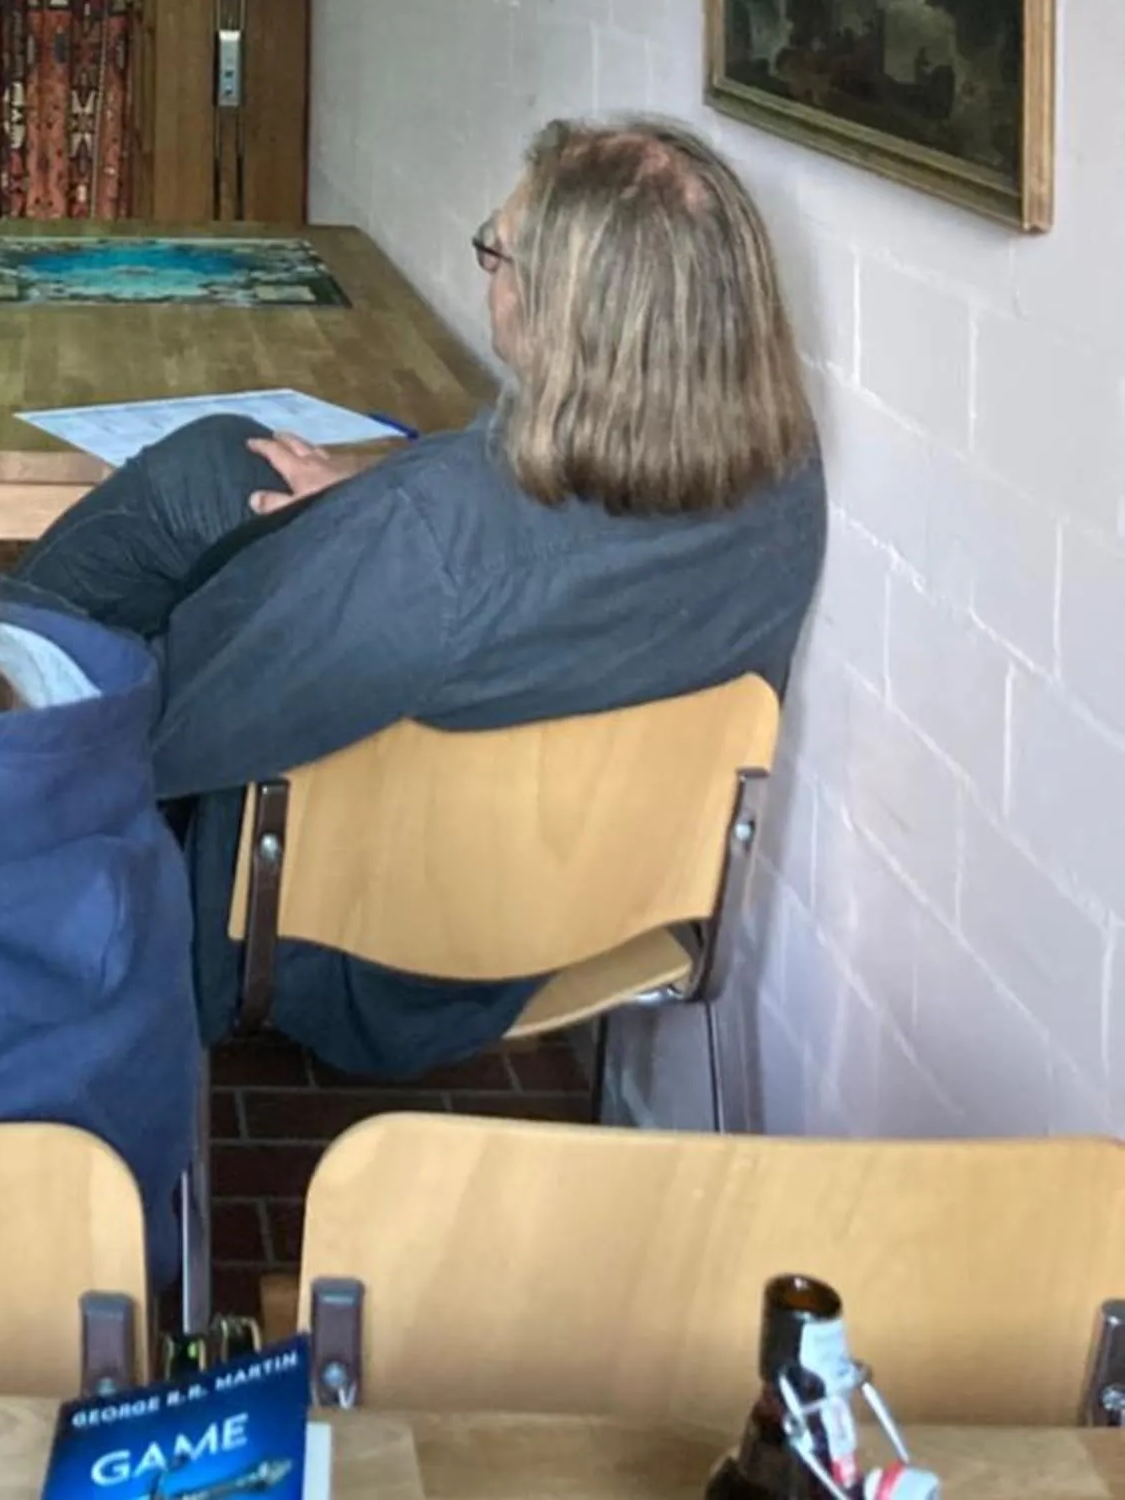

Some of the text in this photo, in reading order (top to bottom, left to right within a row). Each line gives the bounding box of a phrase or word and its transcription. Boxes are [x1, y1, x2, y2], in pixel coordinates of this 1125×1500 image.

[71, 1395, 160, 1428] GEORGE
[215, 1350, 299, 1390] MARTIN
[90, 1412, 249, 1487] GAME
